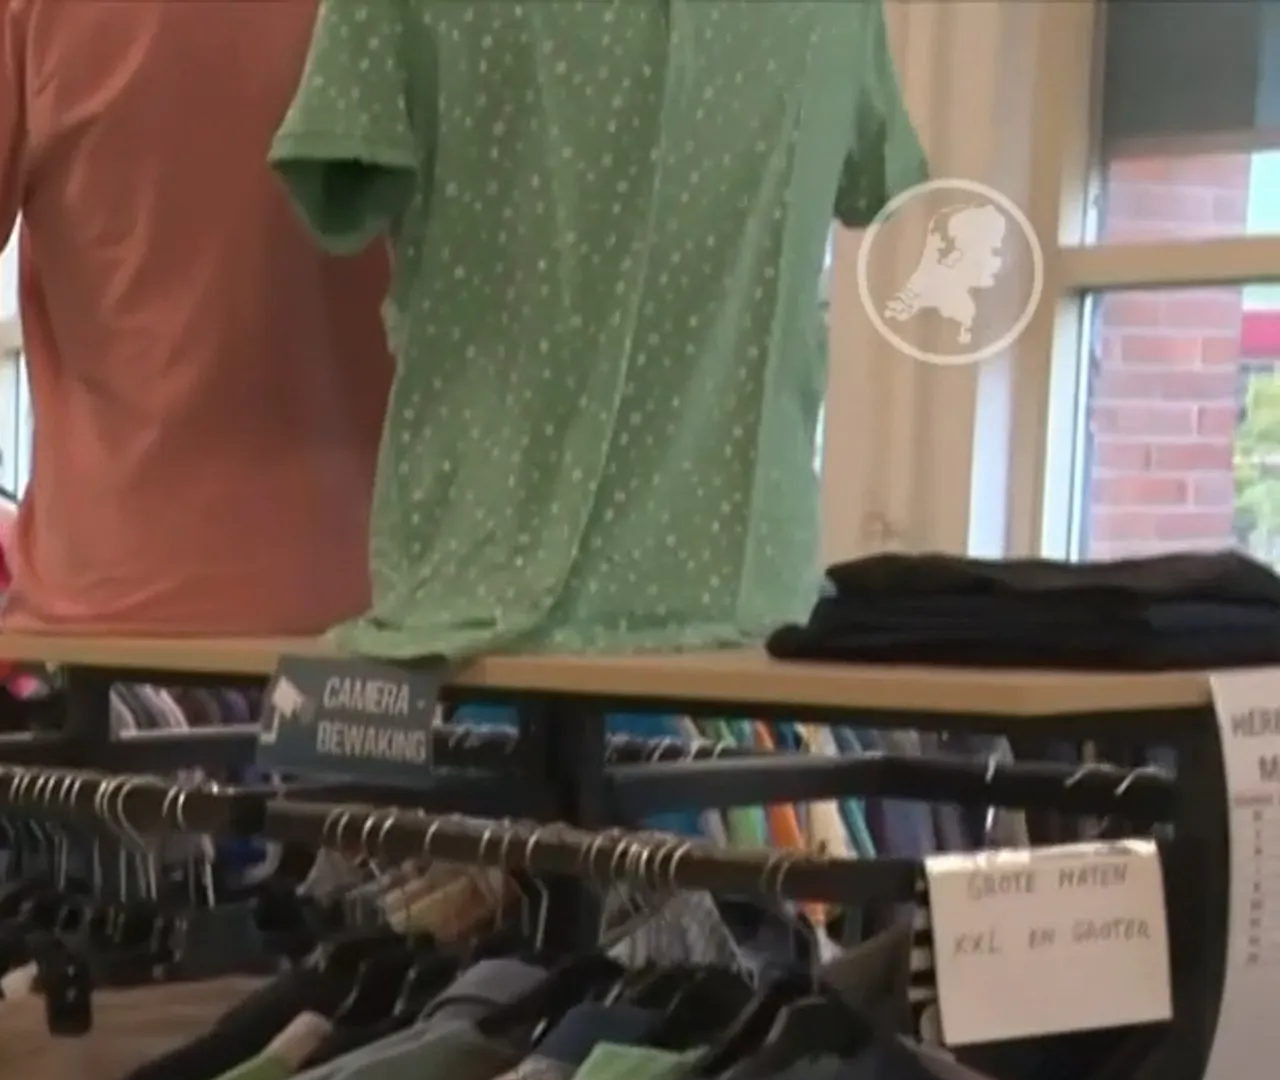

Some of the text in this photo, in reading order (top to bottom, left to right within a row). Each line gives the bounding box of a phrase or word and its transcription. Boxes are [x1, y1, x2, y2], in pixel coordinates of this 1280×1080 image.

[322, 676, 410, 716] CAMERA
[315, 720, 428, 764] BEWAKING
[966, 863, 1129, 901] GROTE MATEN
[953, 917, 1152, 958] XXL EN GROTER
